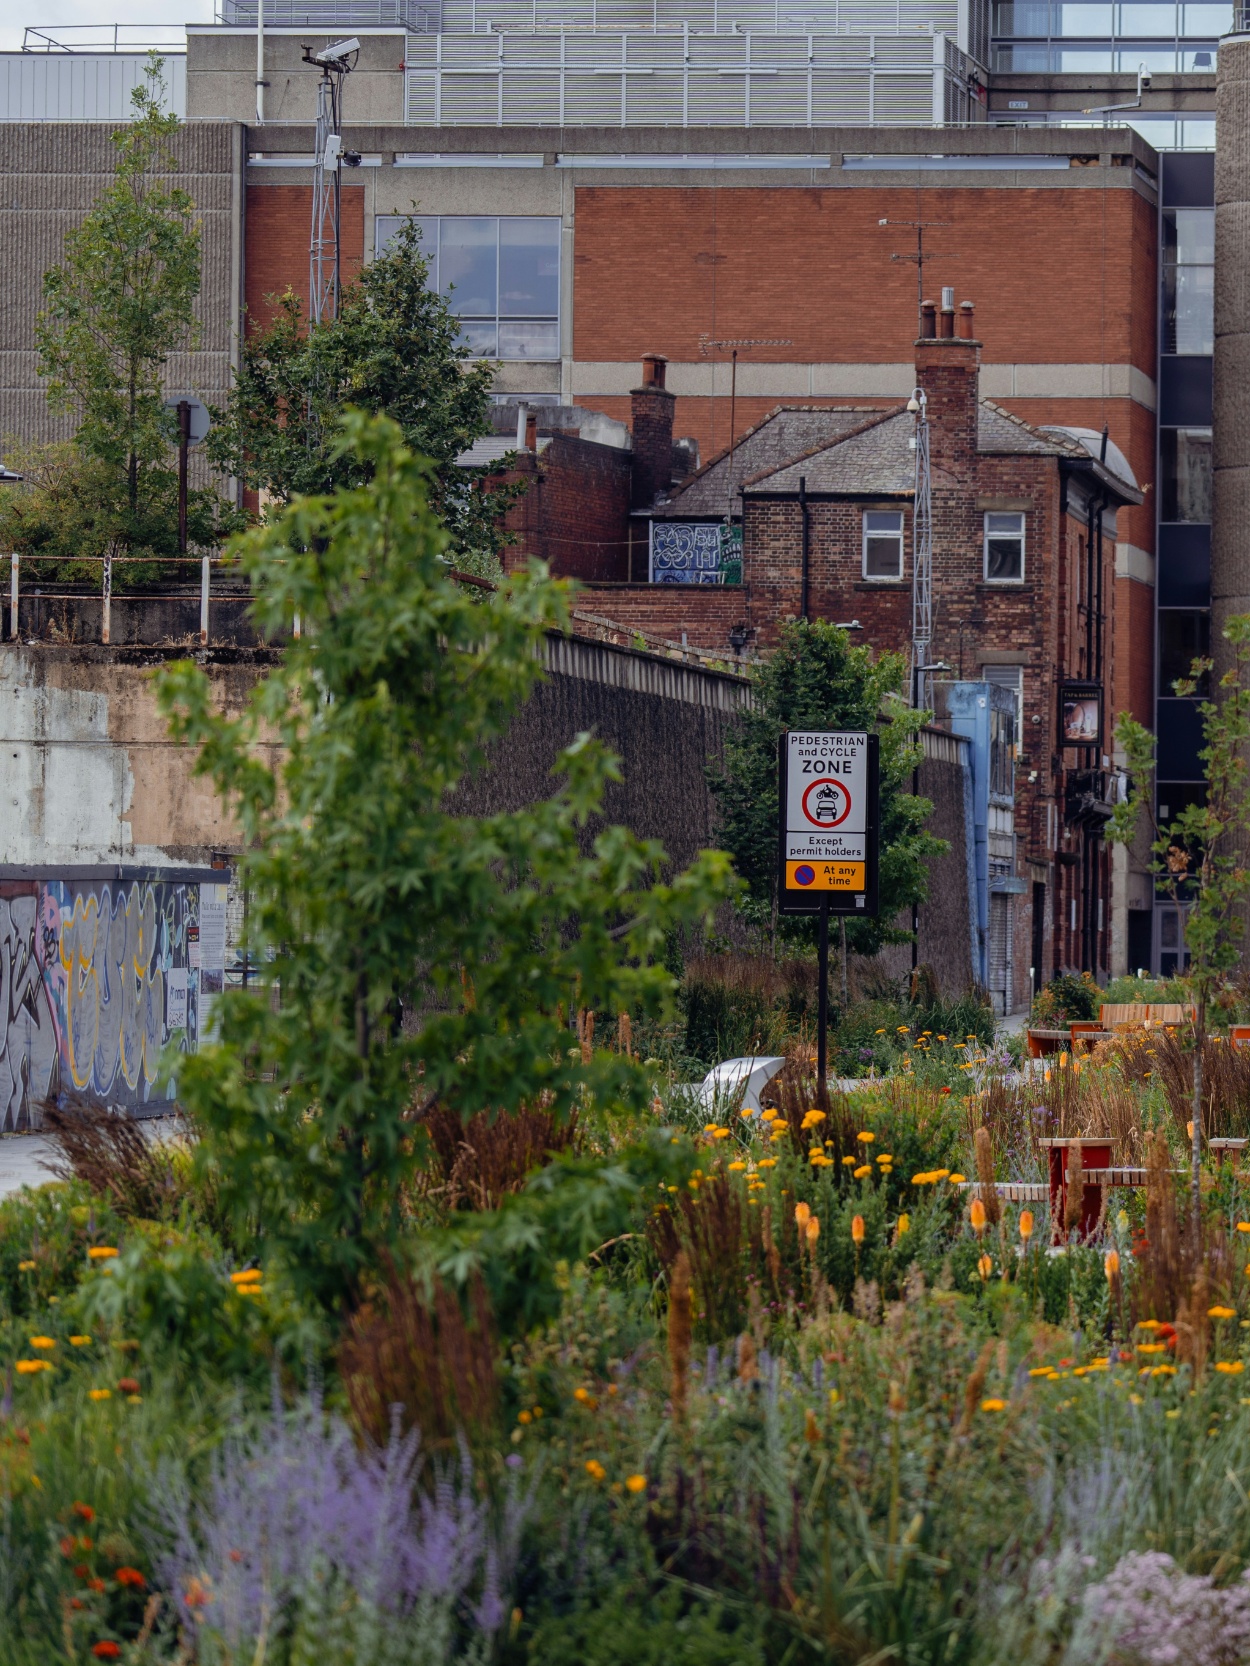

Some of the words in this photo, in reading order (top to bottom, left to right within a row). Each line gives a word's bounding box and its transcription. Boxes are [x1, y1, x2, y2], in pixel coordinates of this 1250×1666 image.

[791, 736, 865, 746] PEDESTRIAN
[798, 748, 818, 757] and
[820, 748, 857, 757] CYCLE
[802, 760, 852, 774] ZONE
[808, 836, 843, 847] Except
[790, 847, 822, 857] permit
[825, 847, 862, 856] holders
[823, 866, 835, 875] At
[838, 867, 857, 877] any
[828, 876, 851, 885] time
